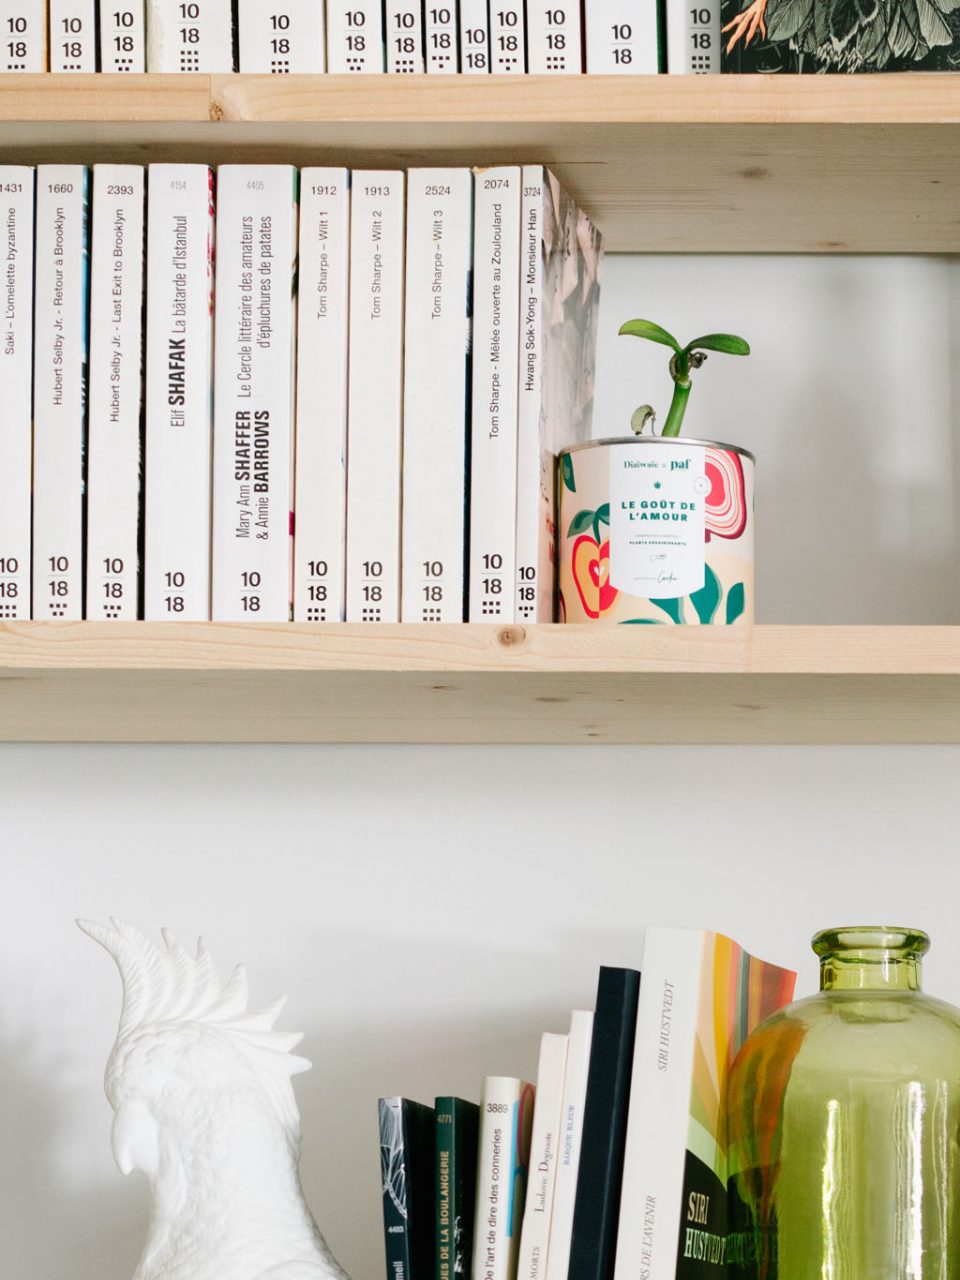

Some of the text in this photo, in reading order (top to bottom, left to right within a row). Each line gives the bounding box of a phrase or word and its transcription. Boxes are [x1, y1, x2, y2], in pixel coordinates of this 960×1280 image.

[62, 18, 81, 33] 10
[63, 42, 82, 57] 18
[108, 185, 133, 195] 2393
[484, 180, 509, 189] 2074
[259, 216, 274, 257] patates
[257, 262, 271, 275] de
[110, 208, 125, 421] Hubert Selby Jr. Last Exit to Brooklyn
[237, 217, 253, 397] Le Cercle littéraire des amateurs
[489, 204, 501, 439] Tom Sharpe Mêlée ouverte au Zoulouland
[254, 411, 269, 492] BARROWS
[235, 411, 253, 537] Mary Ann SHAFFER
[622, 500, 695, 510] LE GOÛT DE
[255, 498, 268, 528] Annie
[308, 561, 327, 576] 10
[308, 586, 327, 601] 18
[658, 980, 674, 1071] SIRI HUSTVEDT
[441, 1151, 449, 1225] BOULANGERIE
[441, 1229, 449, 1242] LA
[441, 1246, 449, 1259] DE
